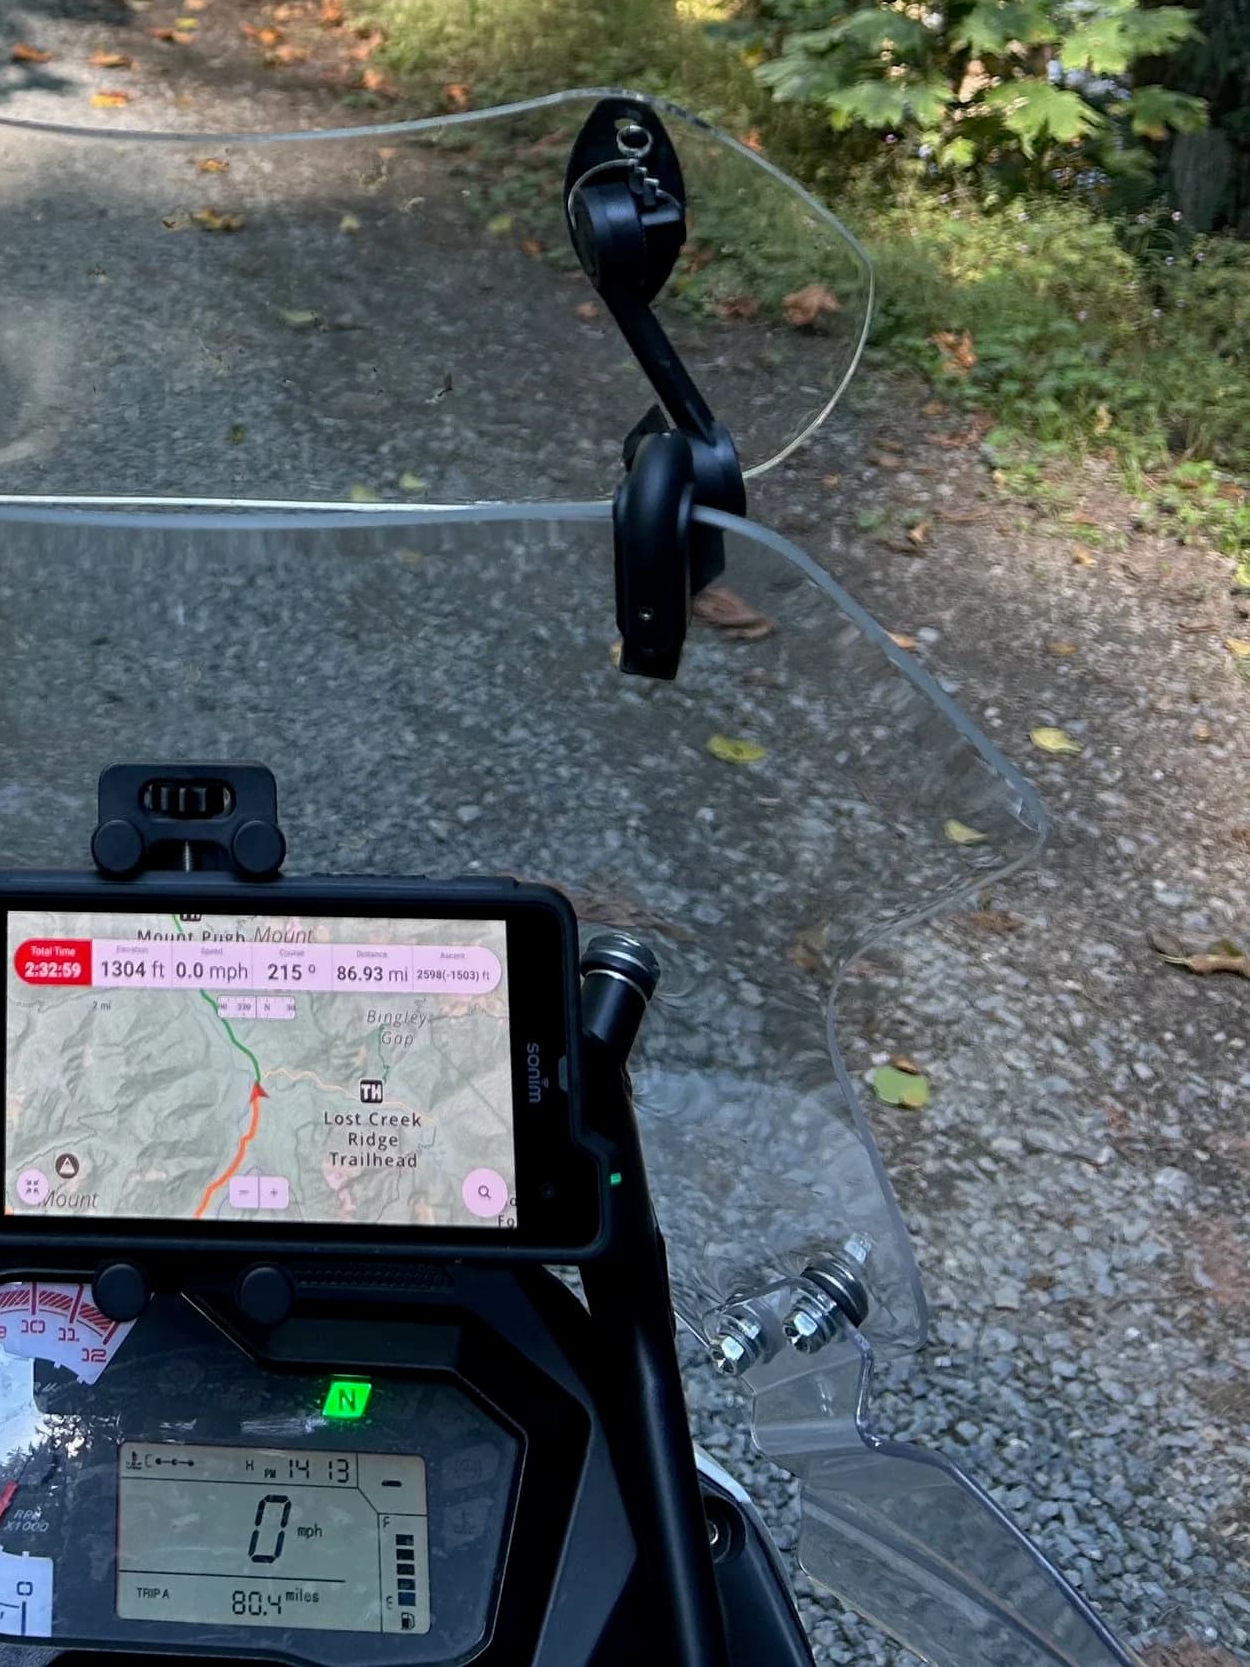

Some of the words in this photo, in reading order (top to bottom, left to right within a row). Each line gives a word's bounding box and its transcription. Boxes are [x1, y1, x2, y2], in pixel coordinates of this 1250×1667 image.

[253, 925, 314, 944] Mount
[30, 944, 52, 956] Total
[54, 944, 77, 956] Time
[23, 960, 83, 978] 2:32:59
[100, 960, 147, 978] 1304
[151, 961, 165, 978] ft
[175, 961, 204, 978] 0.0
[209, 962, 249, 983] mph
[267, 963, 303, 981] 215
[336, 965, 384, 982] 86.93
[388, 967, 409, 983] mi
[366, 1009, 429, 1028] Bingley
[380, 1030, 415, 1048] Gap
[526, 1042, 543, 1104] sonim
[360, 1083, 383, 1101] TH
[323, 1111, 362, 1127] Lost
[368, 1111, 422, 1127] Creek
[347, 1131, 399, 1151] Ridge
[329, 1151, 418, 1168] Trailhead
[338, 1388, 357, 1412] N
[248, 1494, 293, 1565] 0
[296, 1525, 324, 1539] mph
[16, 1580, 34, 1597] 0
[231, 1590, 283, 1617] 80.4
[285, 1588, 320, 1604] miles
